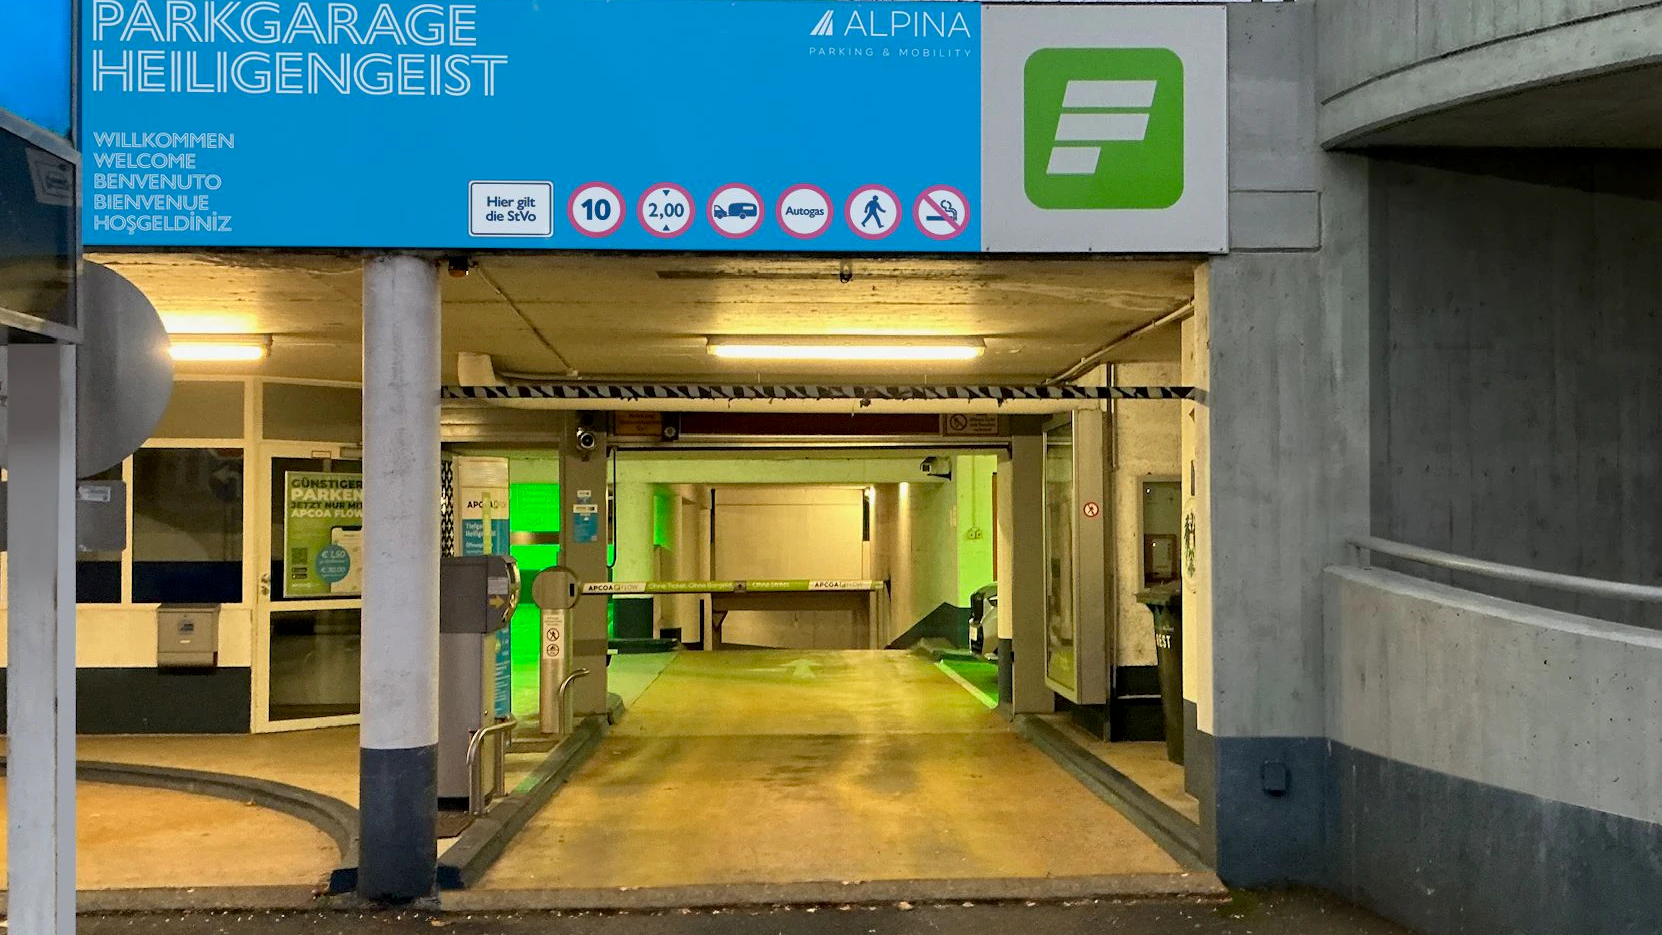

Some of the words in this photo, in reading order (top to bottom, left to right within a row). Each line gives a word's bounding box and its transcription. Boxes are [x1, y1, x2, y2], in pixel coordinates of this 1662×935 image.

[92, 1, 478, 46] PARKGARAGE
[844, 10, 971, 38] ALPINA
[809, 47, 874, 57] PARKING
[882, 48, 890, 57] &
[900, 48, 971, 57] MOBILITY
[92, 50, 508, 96] HEILIGENGEIST
[93, 131, 235, 149] WILLKOMMEN
[93, 152, 196, 169] WELCOME
[94, 172, 222, 190] BENVENUTO
[94, 193, 209, 211] BIENVENUE
[487, 196, 514, 208] Hier
[516, 196, 536, 211] gilt
[581, 198, 611, 221] 10
[649, 202, 685, 219] 2,00
[485, 210, 504, 222] die
[507, 210, 537, 222] StVo
[785, 206, 824, 218] Autogas
[94, 211, 232, 235] HOŞGELDİNİZ
[291, 477, 362, 489] GÜNSTIGER
[291, 488, 362, 501] PARKEN
[291, 501, 321, 509] JETZT
[291, 509, 331, 518] APCOA
[334, 509, 363, 518] FLOW
